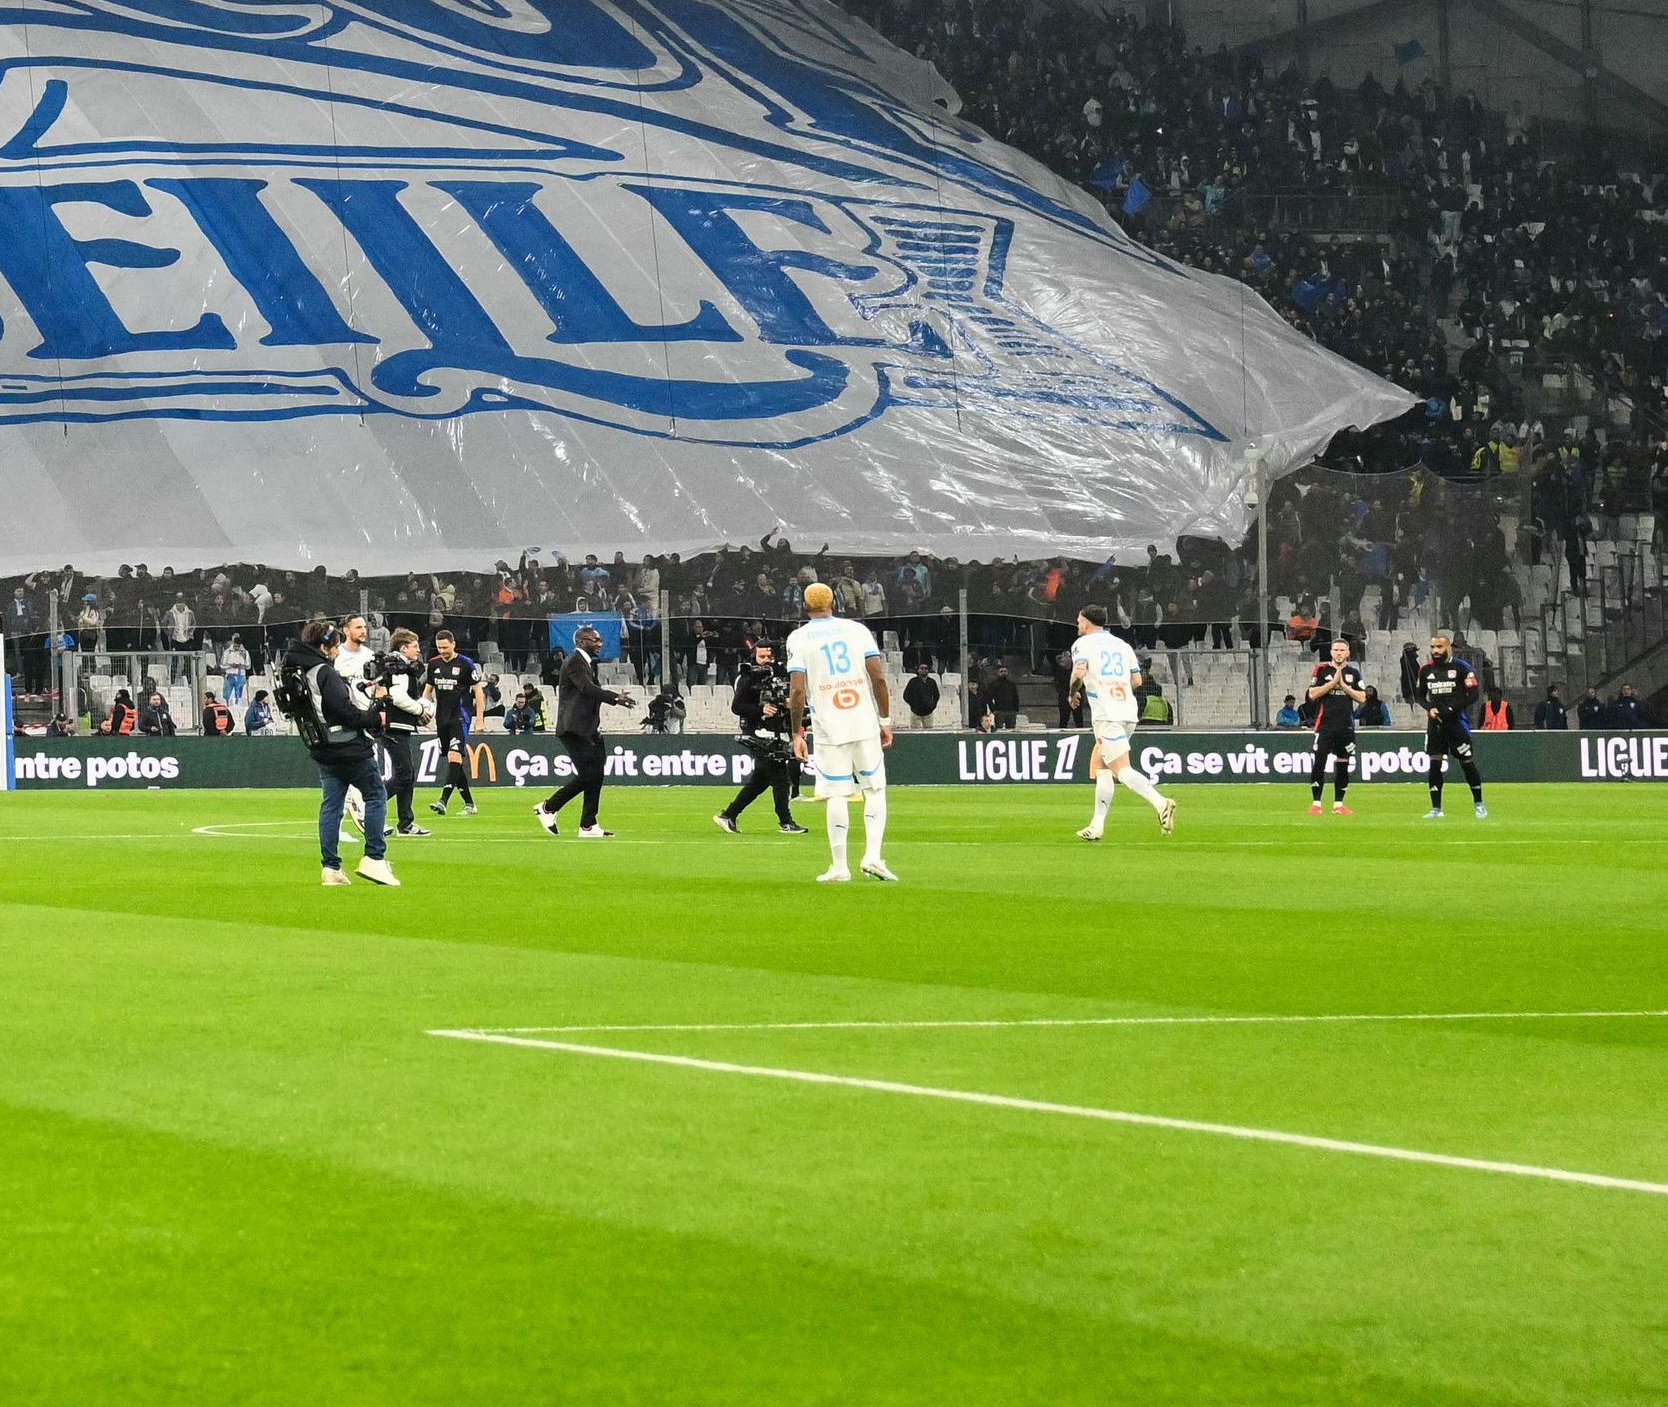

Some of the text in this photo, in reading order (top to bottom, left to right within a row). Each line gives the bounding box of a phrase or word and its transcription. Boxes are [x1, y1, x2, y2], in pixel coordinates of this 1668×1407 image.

[821, 640, 852, 675] 13
[1100, 650, 1124, 676] 23
[87, 752, 179, 786] potos
[506, 749, 548, 786] Ça
[642, 750, 727, 776] entre
[959, 740, 1049, 780] LIGUE
[1140, 746, 1182, 784] Ça
[1187, 752, 1223, 774] se
[1227, 743, 1270, 774] vit
[1581, 737, 1668, 777] LIGUE
